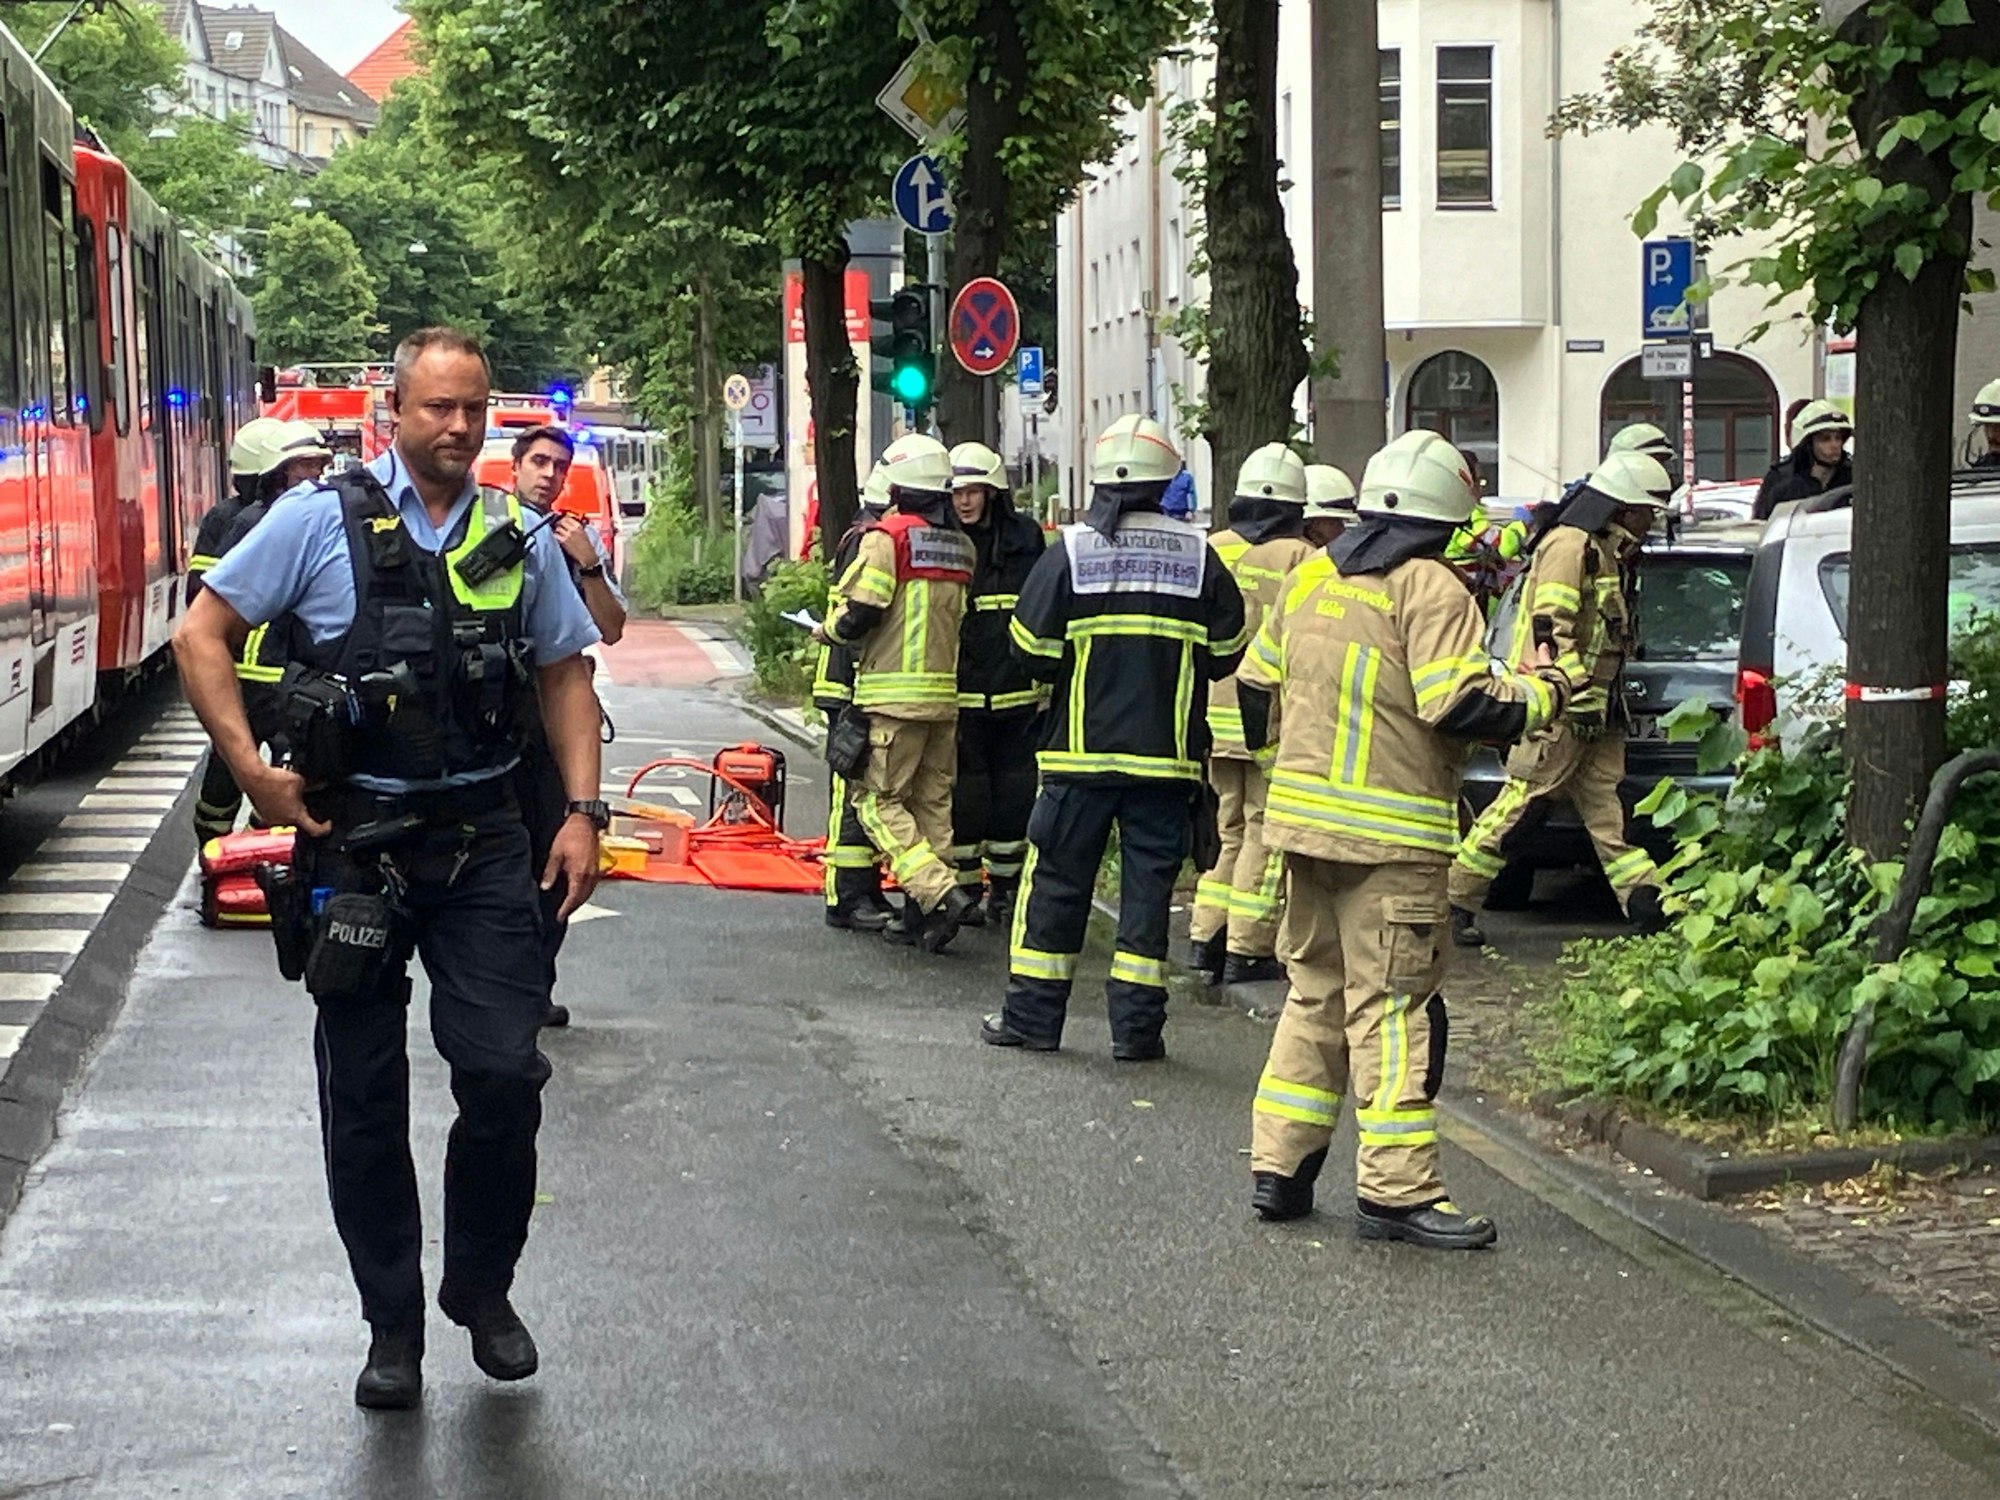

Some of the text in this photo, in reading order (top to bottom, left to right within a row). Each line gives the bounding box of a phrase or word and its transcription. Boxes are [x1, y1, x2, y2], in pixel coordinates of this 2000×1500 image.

[1649, 247, 1672, 287] P
[1021, 351, 1033, 371] P
[1447, 370, 1472, 390] 22
[328, 920, 388, 949] POLIZEI
